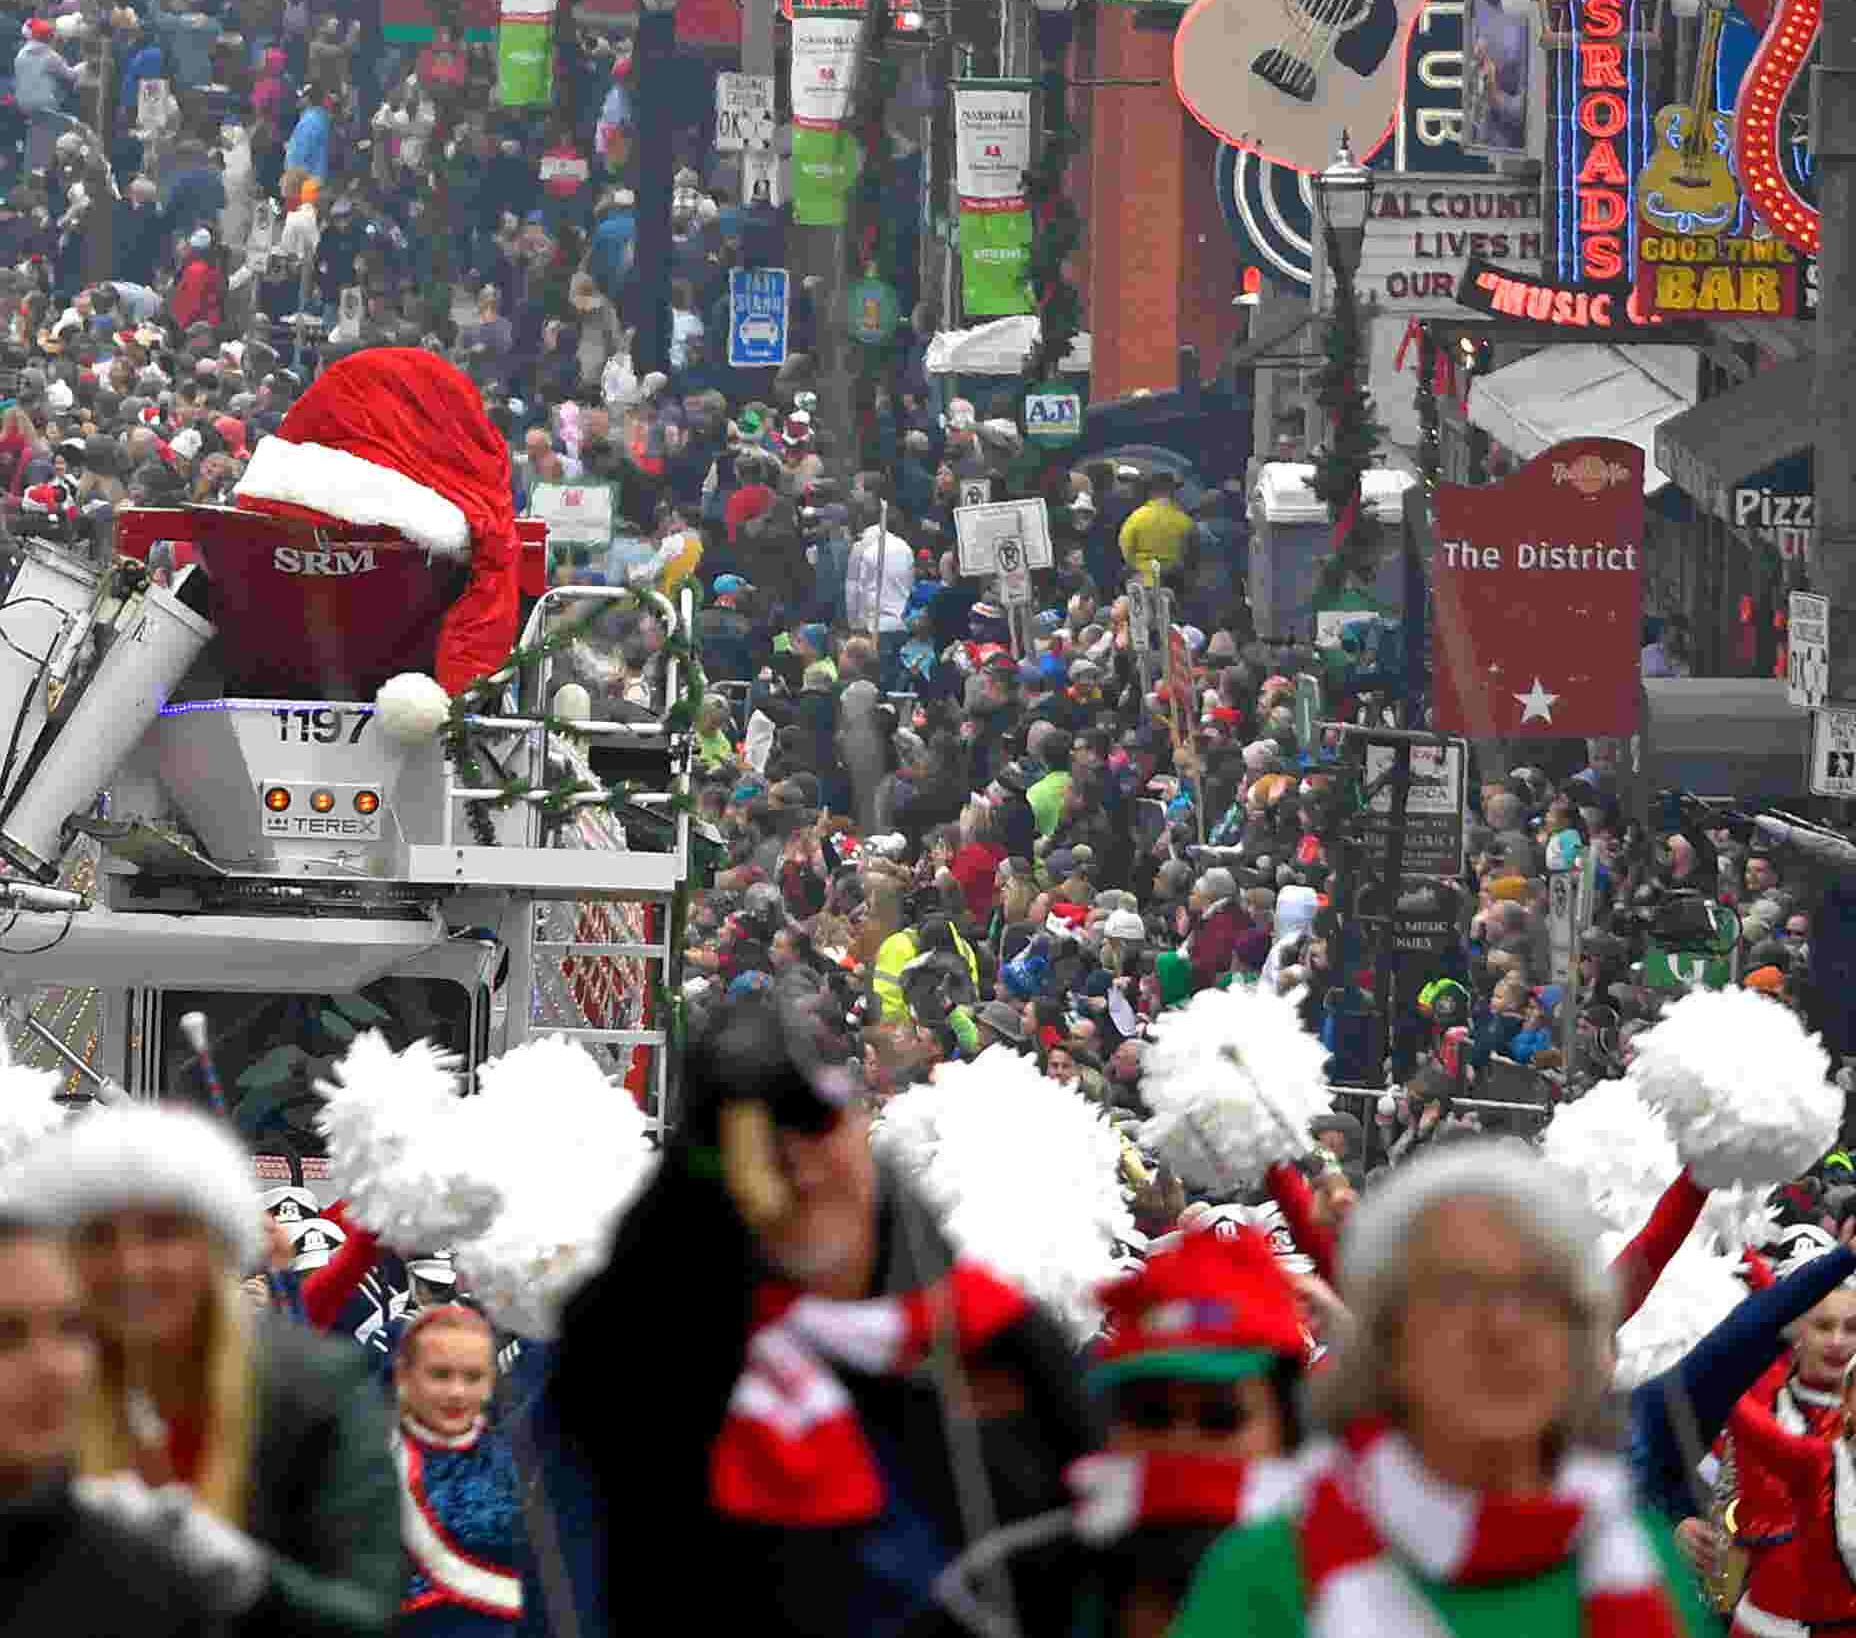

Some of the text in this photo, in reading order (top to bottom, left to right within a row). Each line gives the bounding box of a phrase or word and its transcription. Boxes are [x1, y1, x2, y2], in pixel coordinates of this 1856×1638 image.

[1414, 232, 1510, 259] LIVES
[1388, 270, 1457, 300] OUR
[1654, 267, 1782, 313] BAR
[1736, 487, 1813, 527] Pizz
[272, 545, 378, 575] SRM
[1442, 540, 1639, 571] The District
[272, 708, 375, 745] 1197
[293, 816, 378, 835] TEREX
